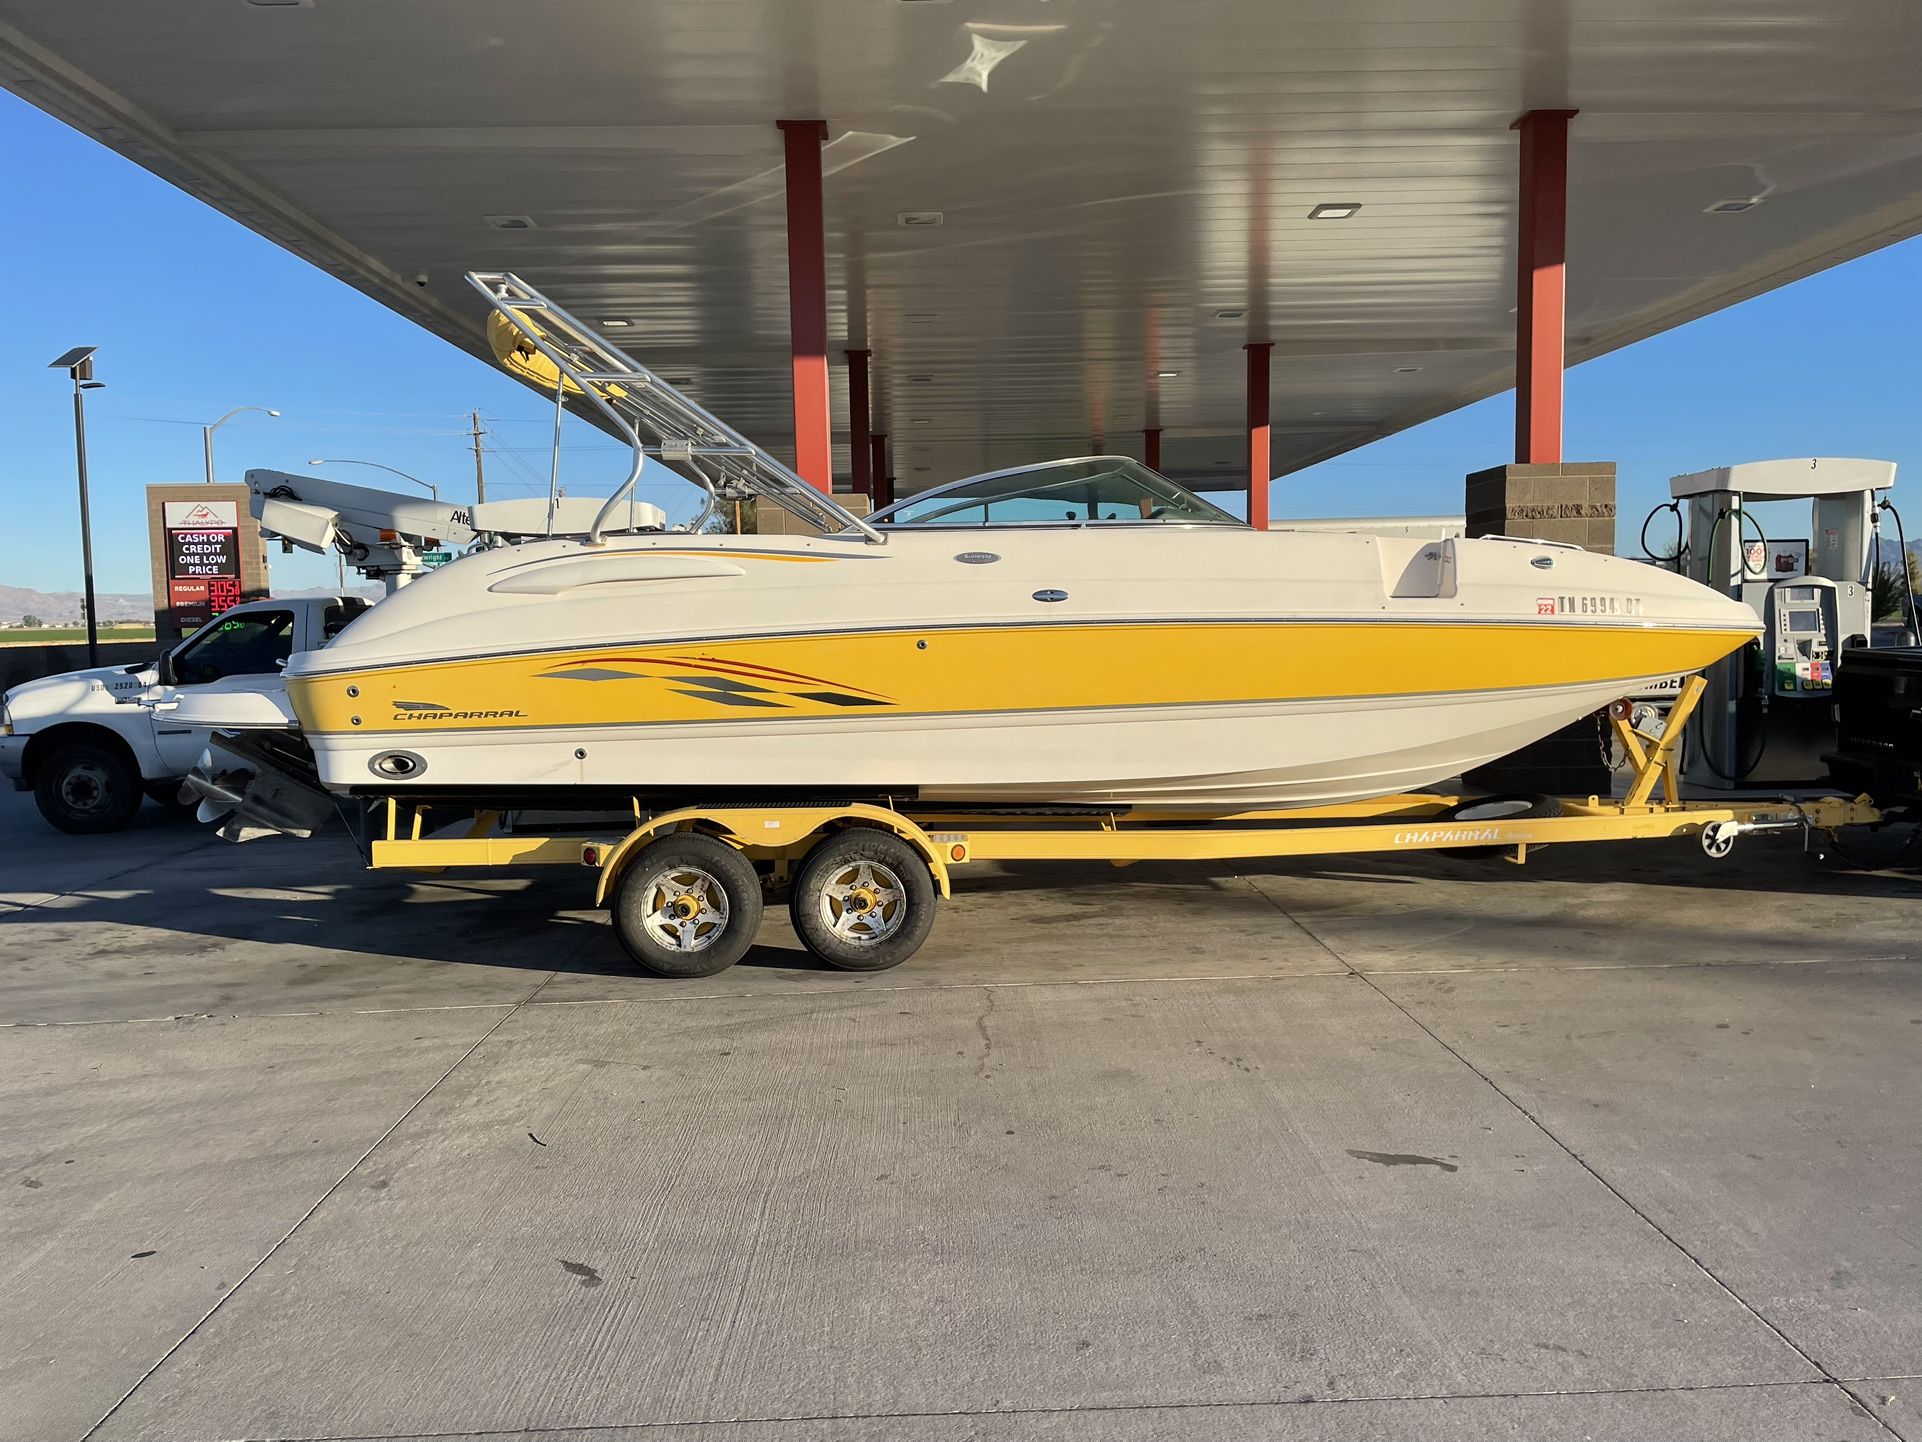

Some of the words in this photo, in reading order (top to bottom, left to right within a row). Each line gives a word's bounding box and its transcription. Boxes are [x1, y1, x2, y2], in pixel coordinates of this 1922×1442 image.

[1811, 458, 1817, 470] 3
[178, 534, 207, 543] CASH
[209, 534, 225, 543] OR
[182, 544, 222, 553] CREDIT
[178, 555, 201, 564] ONE
[203, 555, 227, 564] LOW
[189, 566, 219, 574] PRICE
[1848, 586, 1854, 596] 3
[1540, 605, 1552, 614] 22
[1558, 596, 1576, 613] TN
[1581, 597, 1616, 614] 6994
[392, 709, 529, 721] CHAPARRAL
